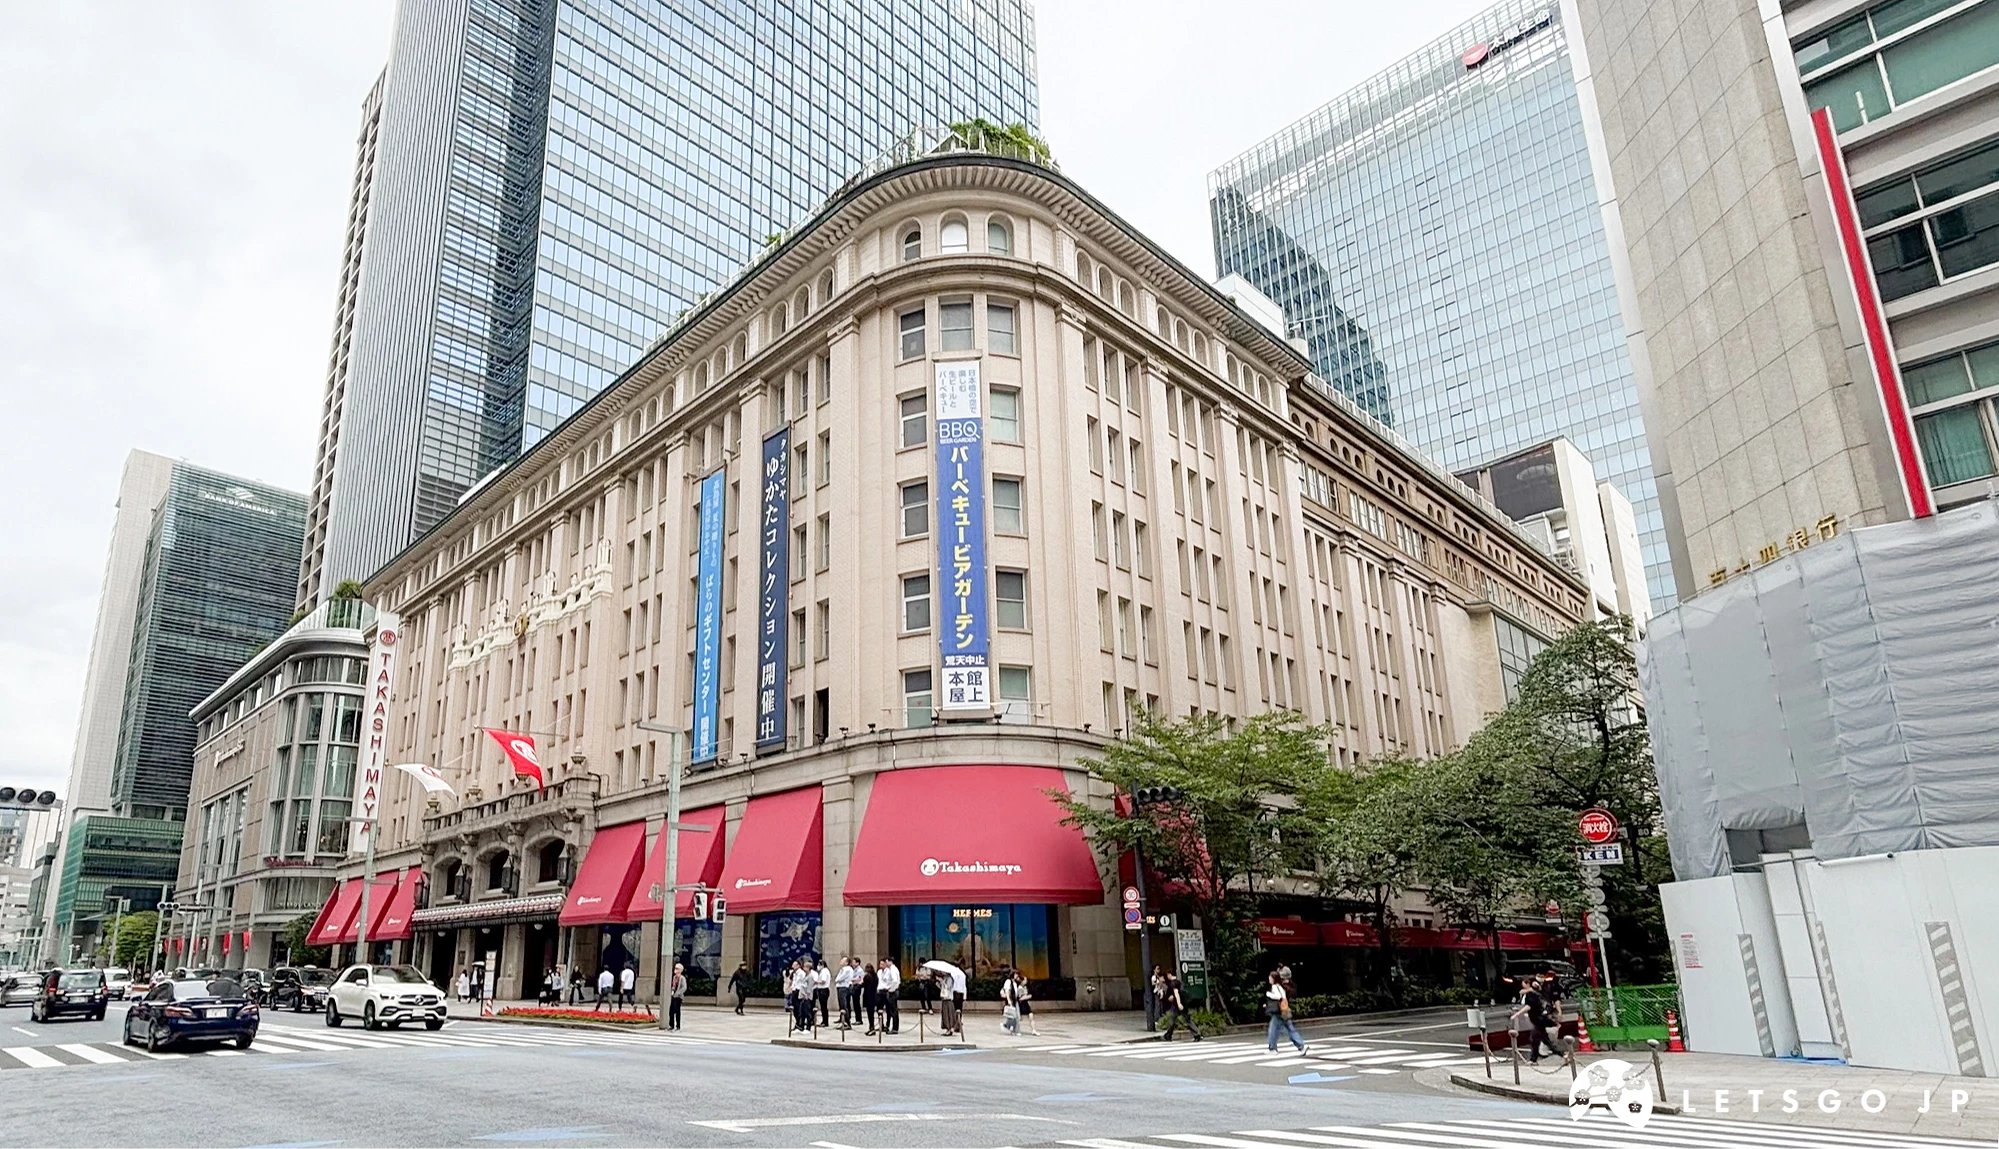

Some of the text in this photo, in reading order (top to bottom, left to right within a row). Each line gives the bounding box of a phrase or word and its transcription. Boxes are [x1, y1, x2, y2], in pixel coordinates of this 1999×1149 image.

[939, 371, 948, 413] バーベキュー
[939, 420, 981, 439] BBQ
[778, 438, 787, 501] タカシマヤ
[204, 492, 228, 504] BANK
[239, 501, 276, 515] AMERICA
[950, 446, 974, 649] バーベキュービアガーデン
[760, 456, 779, 741] ゆかたコレクション開催中
[948, 670, 983, 686] 本館
[949, 687, 984, 703] 屋上
[360, 652, 392, 834] TAKASHIMAYA
[1582, 821, 1609, 834] 消火栓
[939, 861, 1022, 875] Takashimaya
